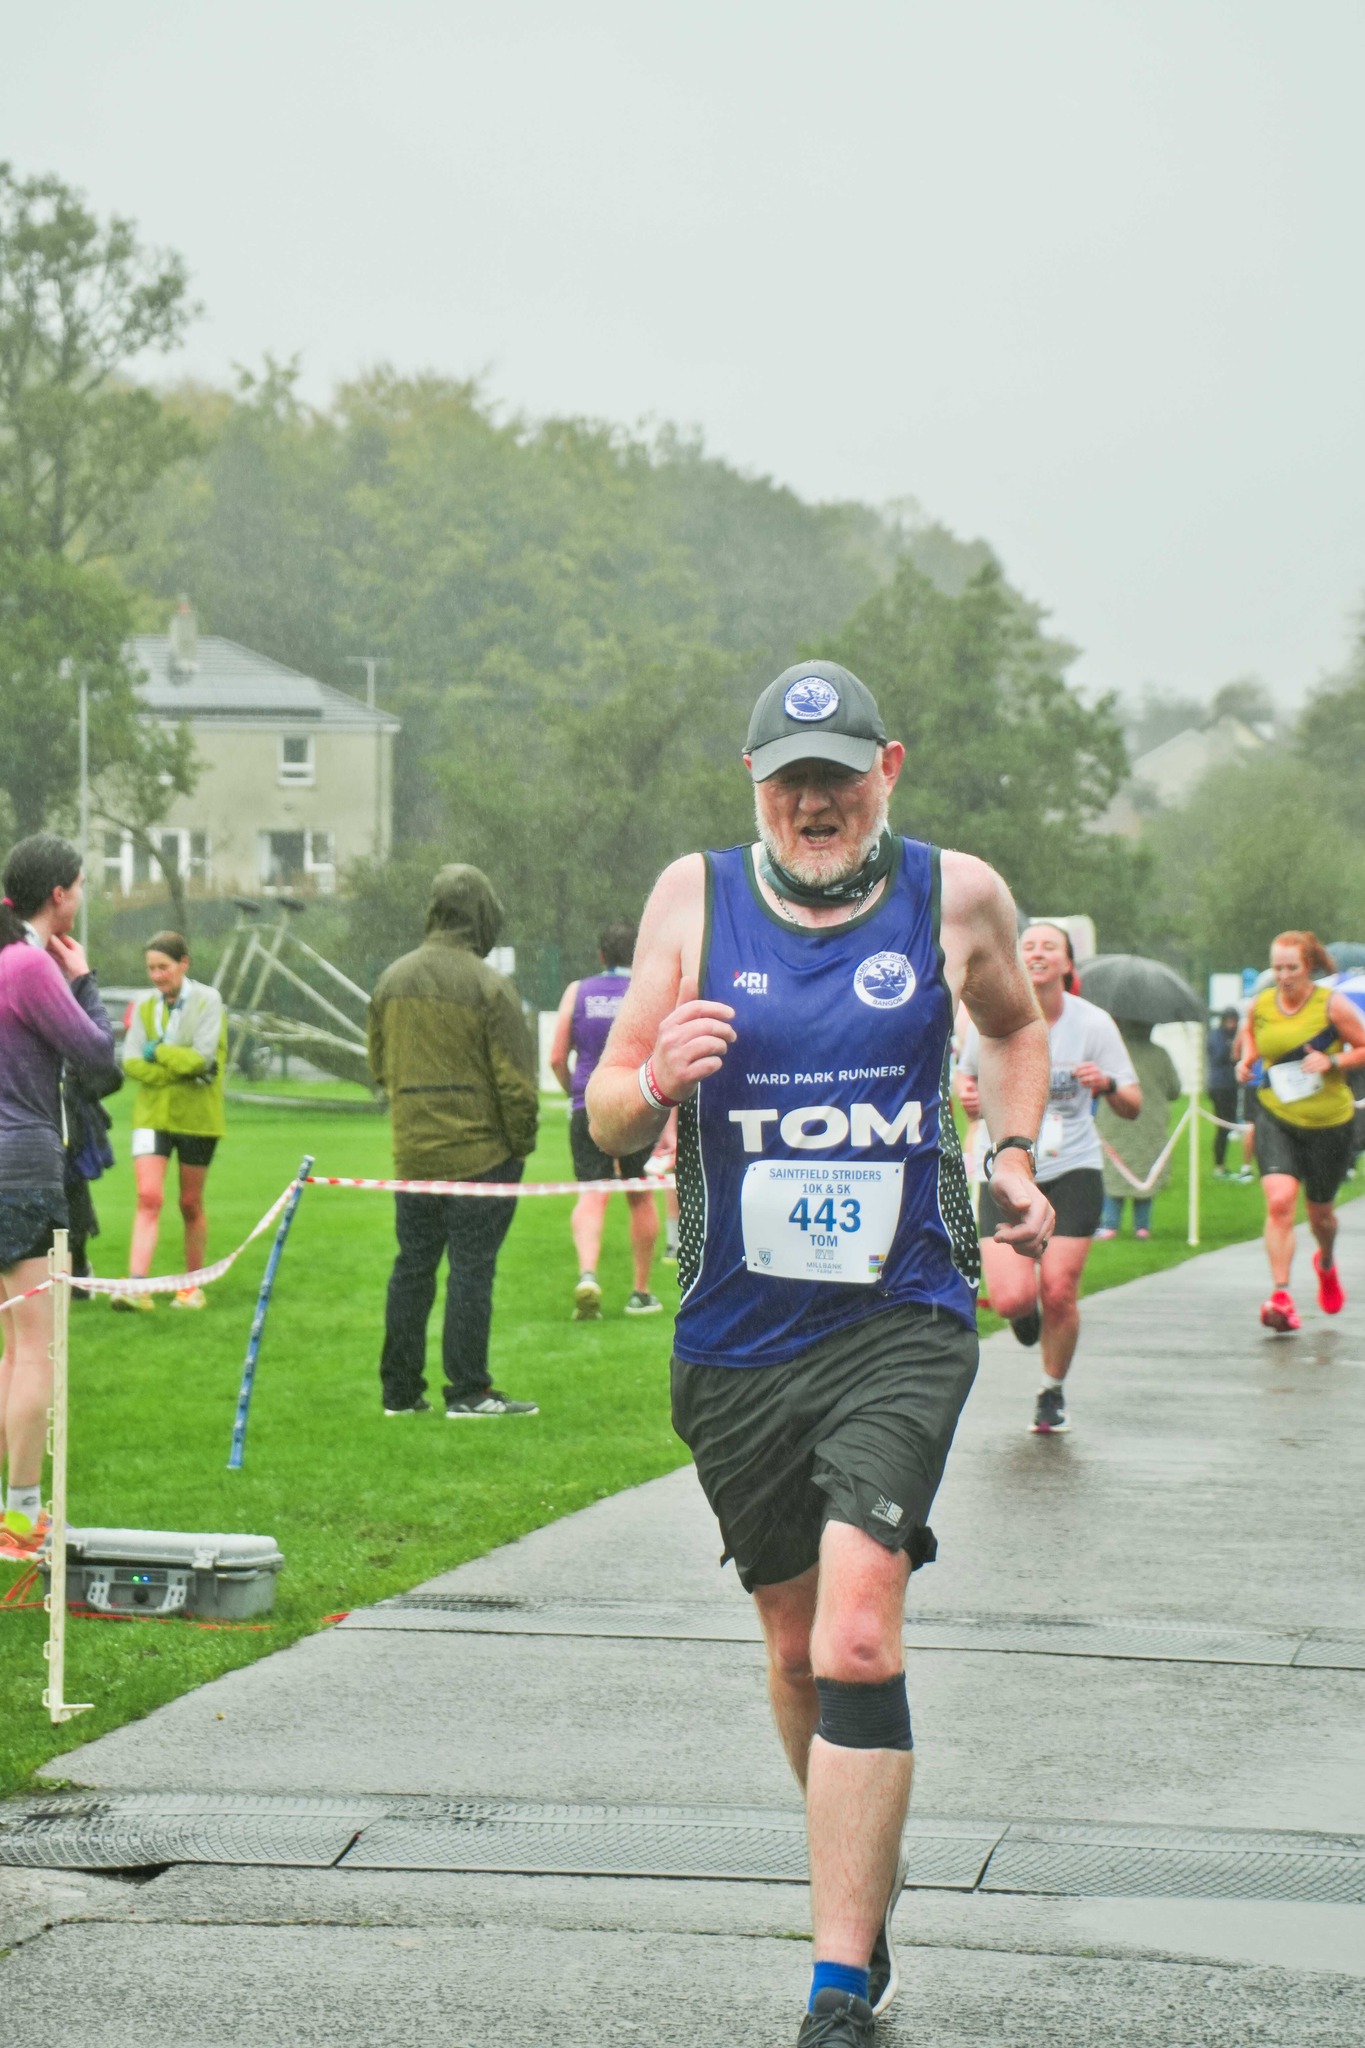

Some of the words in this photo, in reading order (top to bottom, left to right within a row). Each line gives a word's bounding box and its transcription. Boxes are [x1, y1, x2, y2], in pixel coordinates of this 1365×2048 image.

[856, 963, 869, 985] WARD
[747, 987, 768, 996] sport
[872, 997, 903, 1006] BANGOR
[747, 1073, 790, 1085] WARD
[795, 1072, 834, 1084] PARK
[838, 1065, 906, 1081] RUNNERS
[652, 1088, 662, 1100] 100
[728, 1101, 923, 1153] TOM
[769, 1168, 829, 1180] SAINTFIELD
[832, 1170, 882, 1181] STRIDERS
[802, 1184, 823, 1194] 10K
[825, 1184, 834, 1194] &
[837, 1184, 851, 1194] 5K
[788, 1197, 861, 1233] 443
[809, 1235, 838, 1247] TOM
[806, 1262, 842, 1270] MILLBANK
